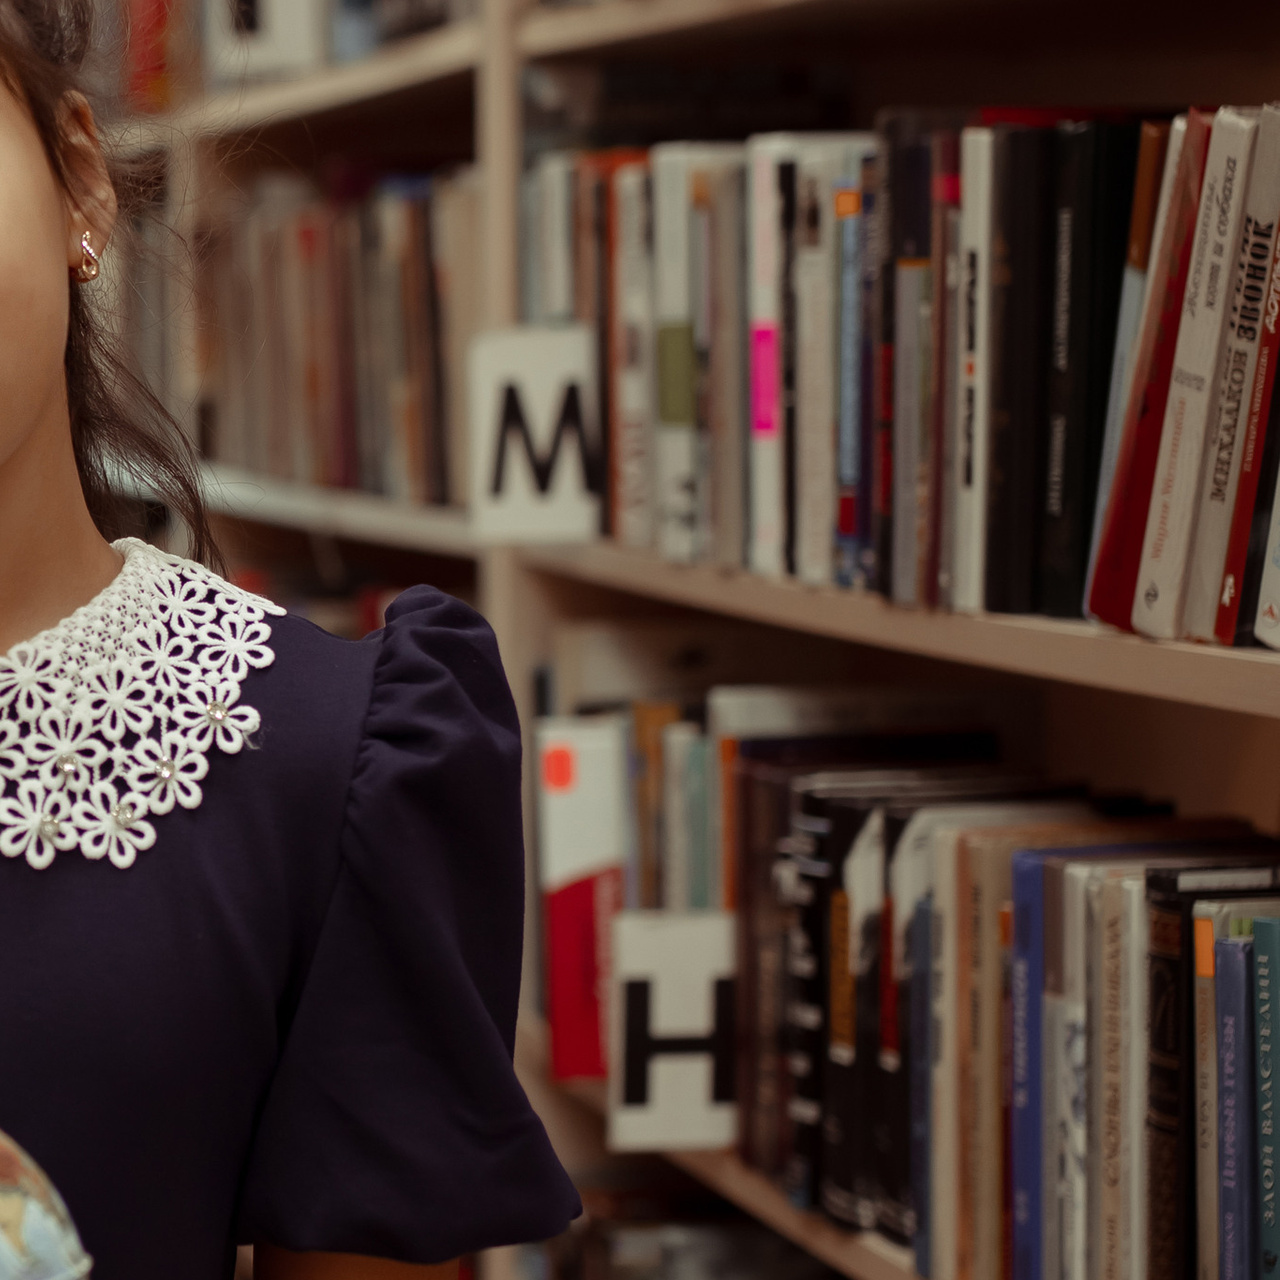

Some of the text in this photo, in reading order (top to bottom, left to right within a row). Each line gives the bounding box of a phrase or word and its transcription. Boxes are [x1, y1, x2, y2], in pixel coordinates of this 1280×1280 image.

[1210, 349, 1248, 504] МИХАЛКОВ
[1237, 220, 1275, 342] ЗВОНОК
[493, 382, 601, 502] М
[622, 978, 735, 1106] Н
[1256, 953, 1274, 1135] ВЛАСТЕЛИН
[1259, 1144, 1276, 1227] ЗЛОЙ
